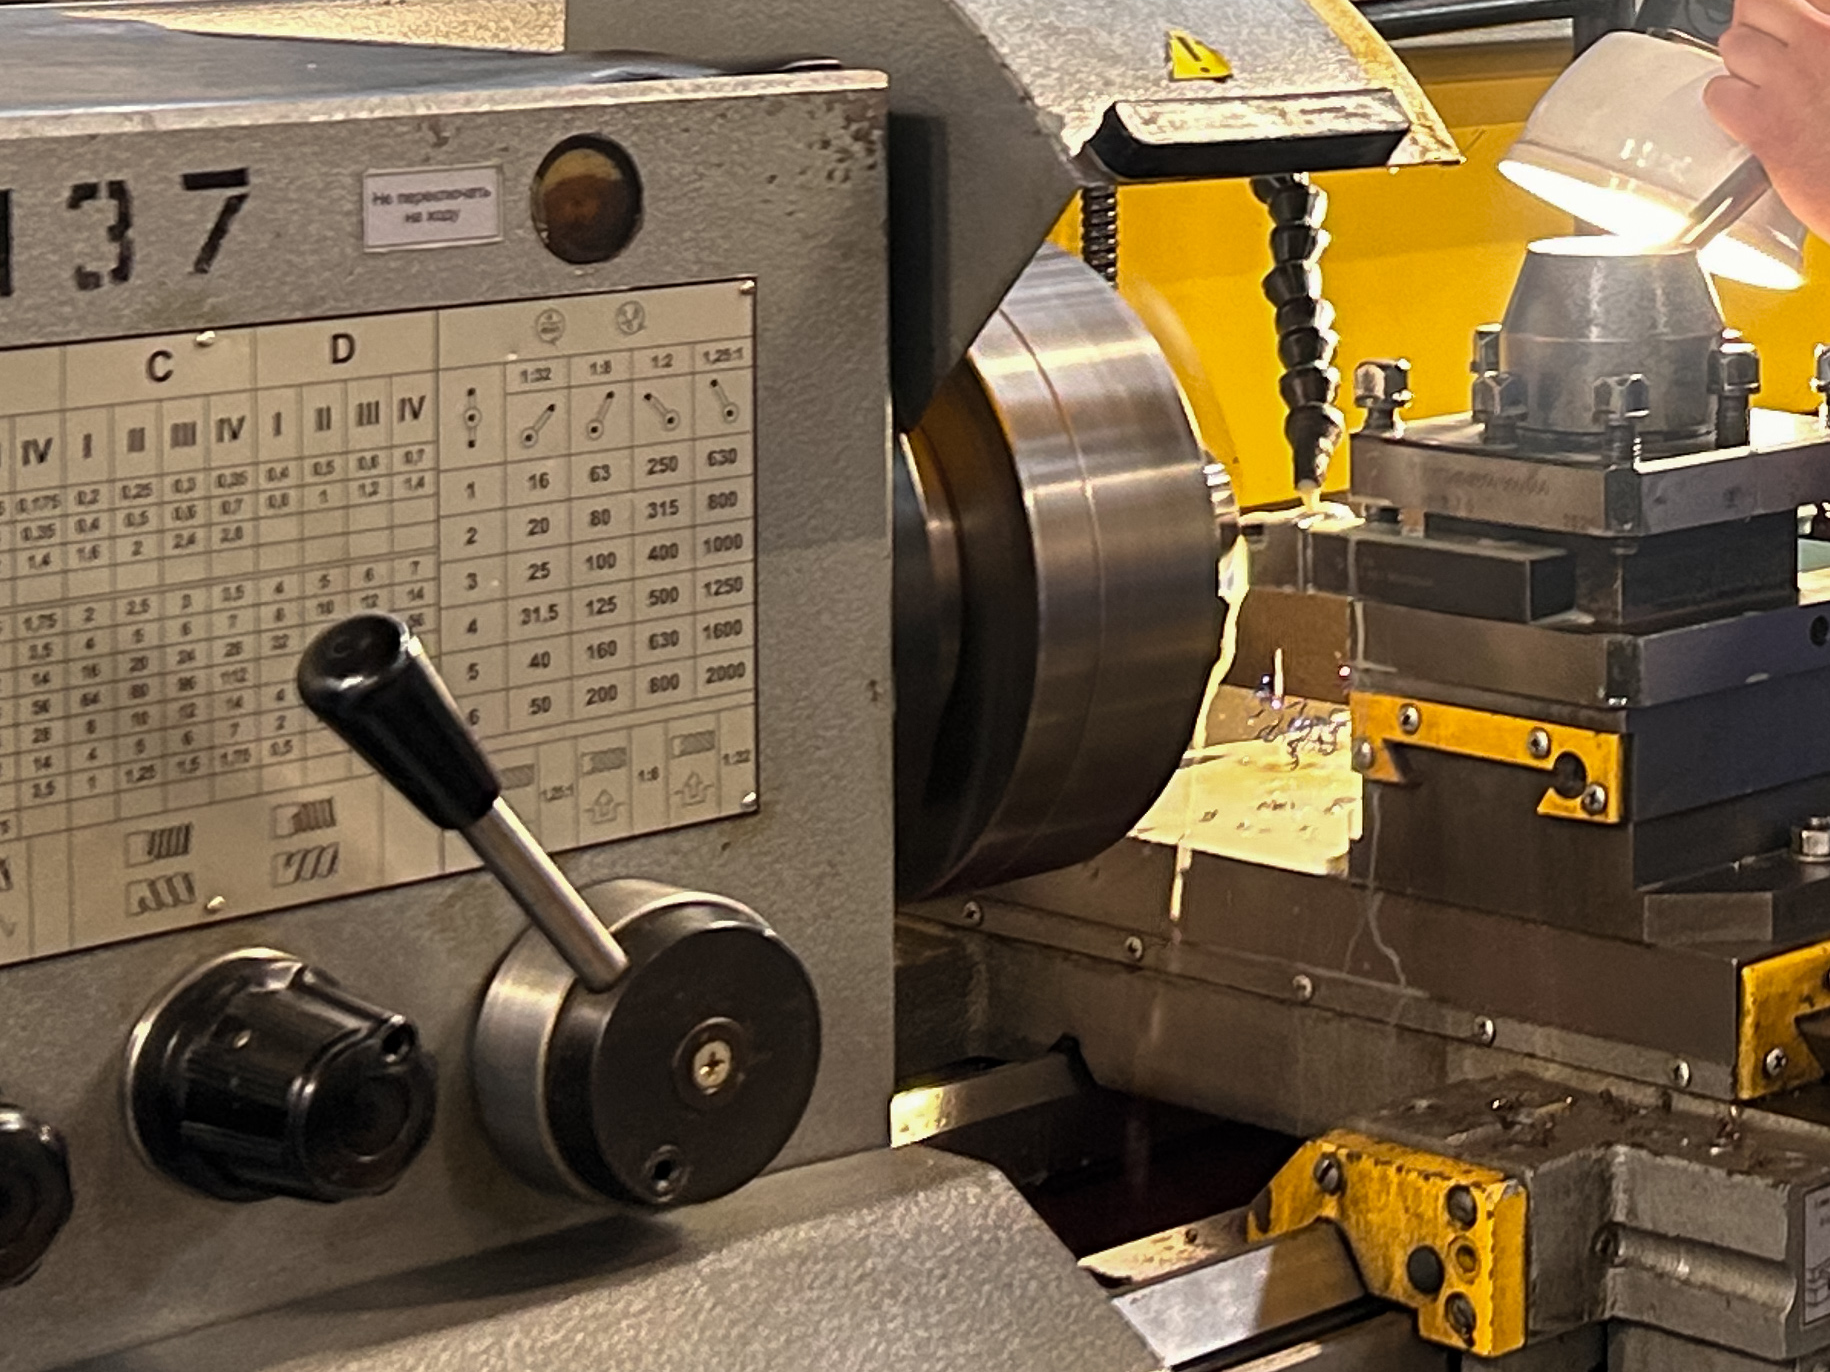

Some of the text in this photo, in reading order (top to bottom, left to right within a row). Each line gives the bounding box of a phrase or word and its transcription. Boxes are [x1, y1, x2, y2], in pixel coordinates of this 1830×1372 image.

[146, 332, 356, 383] C D
[21, 437, 53, 466] IV
[216, 415, 246, 443] IV
[272, 411, 282, 438] I
[314, 406, 332, 432] II
[356, 400, 380, 427] III
[398, 395, 426, 424] IV
[464, 448, 738, 500] 1 16 63 250 630
[464, 490, 738, 546] 2 20 80 315 800
[464, 532, 744, 591] 3 25 100 400 1000
[466, 618, 478, 635] 4
[585, 595, 617, 617] 125
[648, 586, 680, 606] 500
[703, 576, 744, 598] 1250
[468, 618, 744, 681] 5 40 160 630 1600
[468, 662, 746, 726] 6 50 200 800 2000
